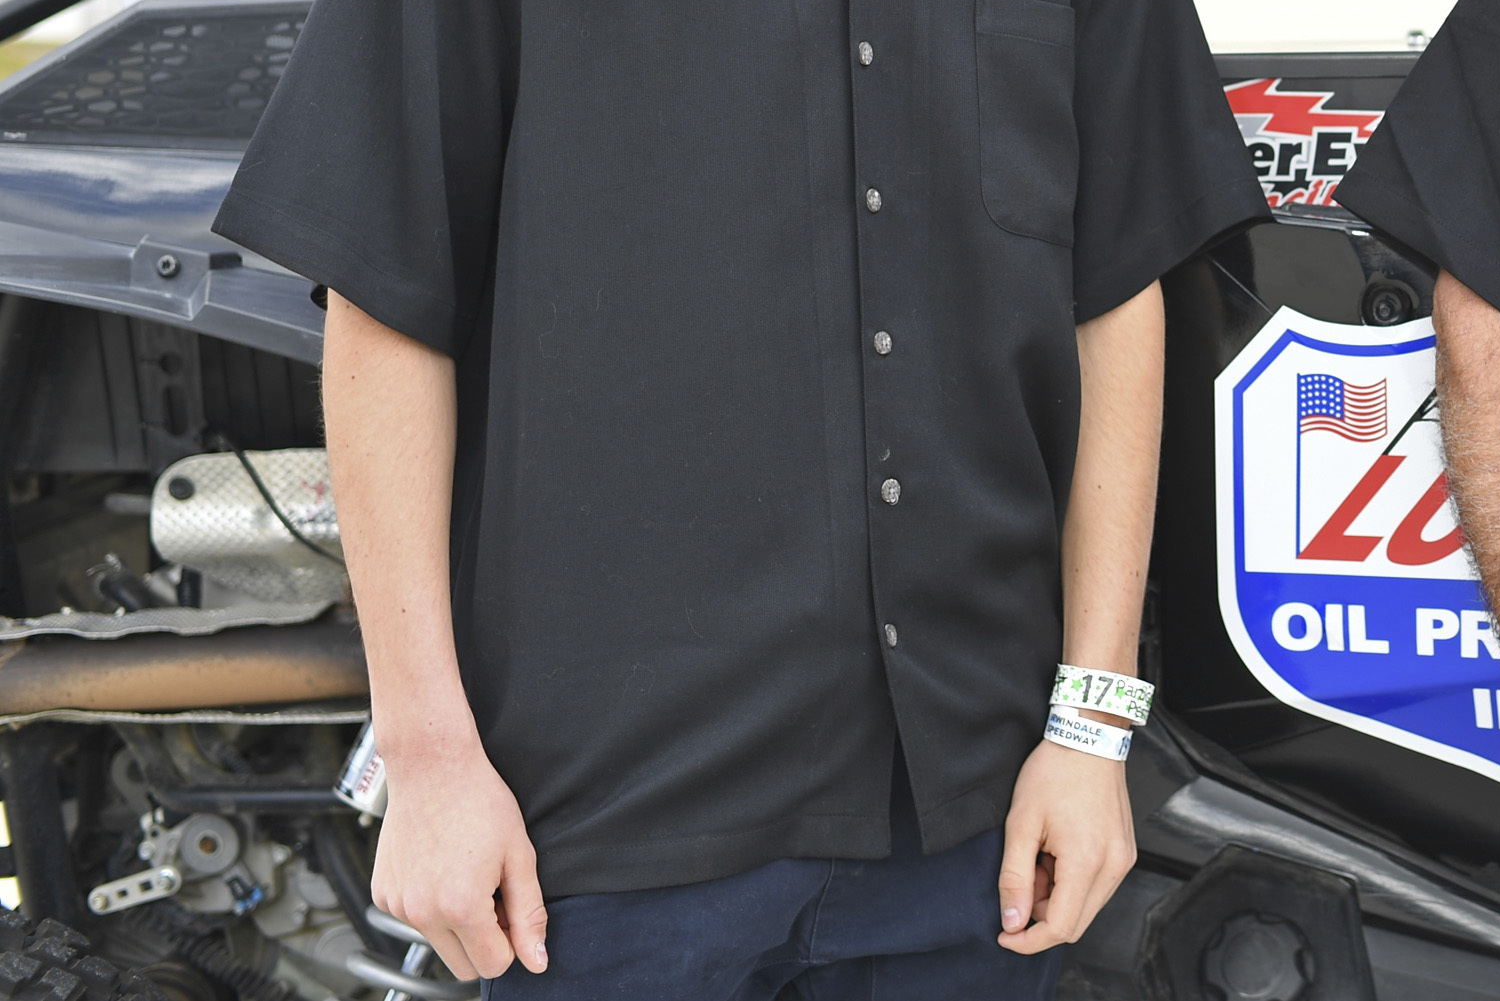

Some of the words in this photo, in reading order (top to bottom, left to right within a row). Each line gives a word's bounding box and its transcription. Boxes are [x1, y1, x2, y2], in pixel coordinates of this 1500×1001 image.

[1311, 132, 1366, 176] E
[1271, 602, 1390, 654] OIL
[1082, 674, 1114, 705] 17
